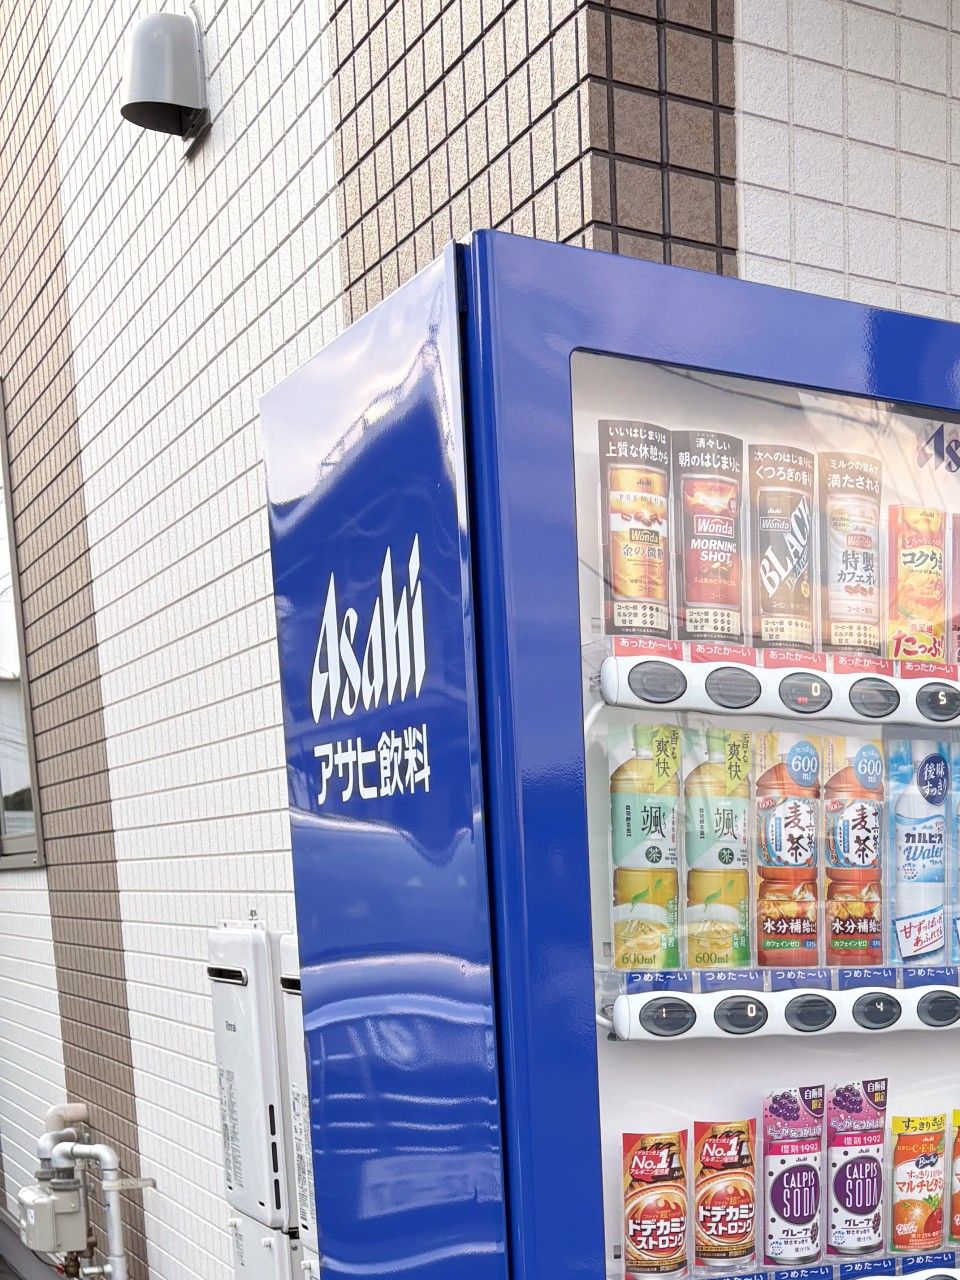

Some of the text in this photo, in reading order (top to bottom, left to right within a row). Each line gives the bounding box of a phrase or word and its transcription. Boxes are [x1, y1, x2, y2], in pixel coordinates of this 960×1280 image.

[606, 441, 668, 464] 上質な休憩から
[679, 452, 740, 472] 朝のはじまりに
[828, 474, 879, 493] 満たされる
[698, 519, 733, 534] Wonda
[762, 519, 789, 529] Wonda
[631, 530, 659, 543] Wonda
[691, 539, 736, 553] MORNING
[700, 551, 732, 564] SHOT
[842, 550, 874, 572] 特製
[838, 571, 876, 585] カフェオレ
[311, 532, 426, 724] Asahi
[894, 633, 944, 658] たっぷり
[313, 723, 431, 806] アサヒ飲料
[655, 738, 670, 777] 爽快
[728, 741, 741, 781] 爽快
[791, 756, 818, 772] 600
[858, 759, 881, 775] 600
[924, 761, 945, 780] 後味
[922, 778, 947, 798] すっきり
[641, 805, 666, 838] 颯
[714, 808, 738, 840] 颯
[784, 801, 808, 863] 麦茶
[852, 805, 874, 864] 麦茶
[905, 833, 943, 844] カルピス
[904, 845, 943, 861] Water
[763, 918, 816, 934] 水分補給に
[622, 952, 656, 965] 600ml
[695, 951, 729, 964] 600ml
[701, 1137, 739, 1157] No.1
[631, 1148, 669, 1169] No.1
[846, 1162, 877, 1178] CALPIS
[783, 1171, 815, 1188] CALPIS
[846, 1178, 878, 1207] SODA
[783, 1187, 816, 1217] SODA
[706, 1219, 751, 1236] ストロング
[844, 1219, 872, 1227] グレープ
[636, 1233, 683, 1250] ストロング
[782, 1228, 810, 1237] グレープ
